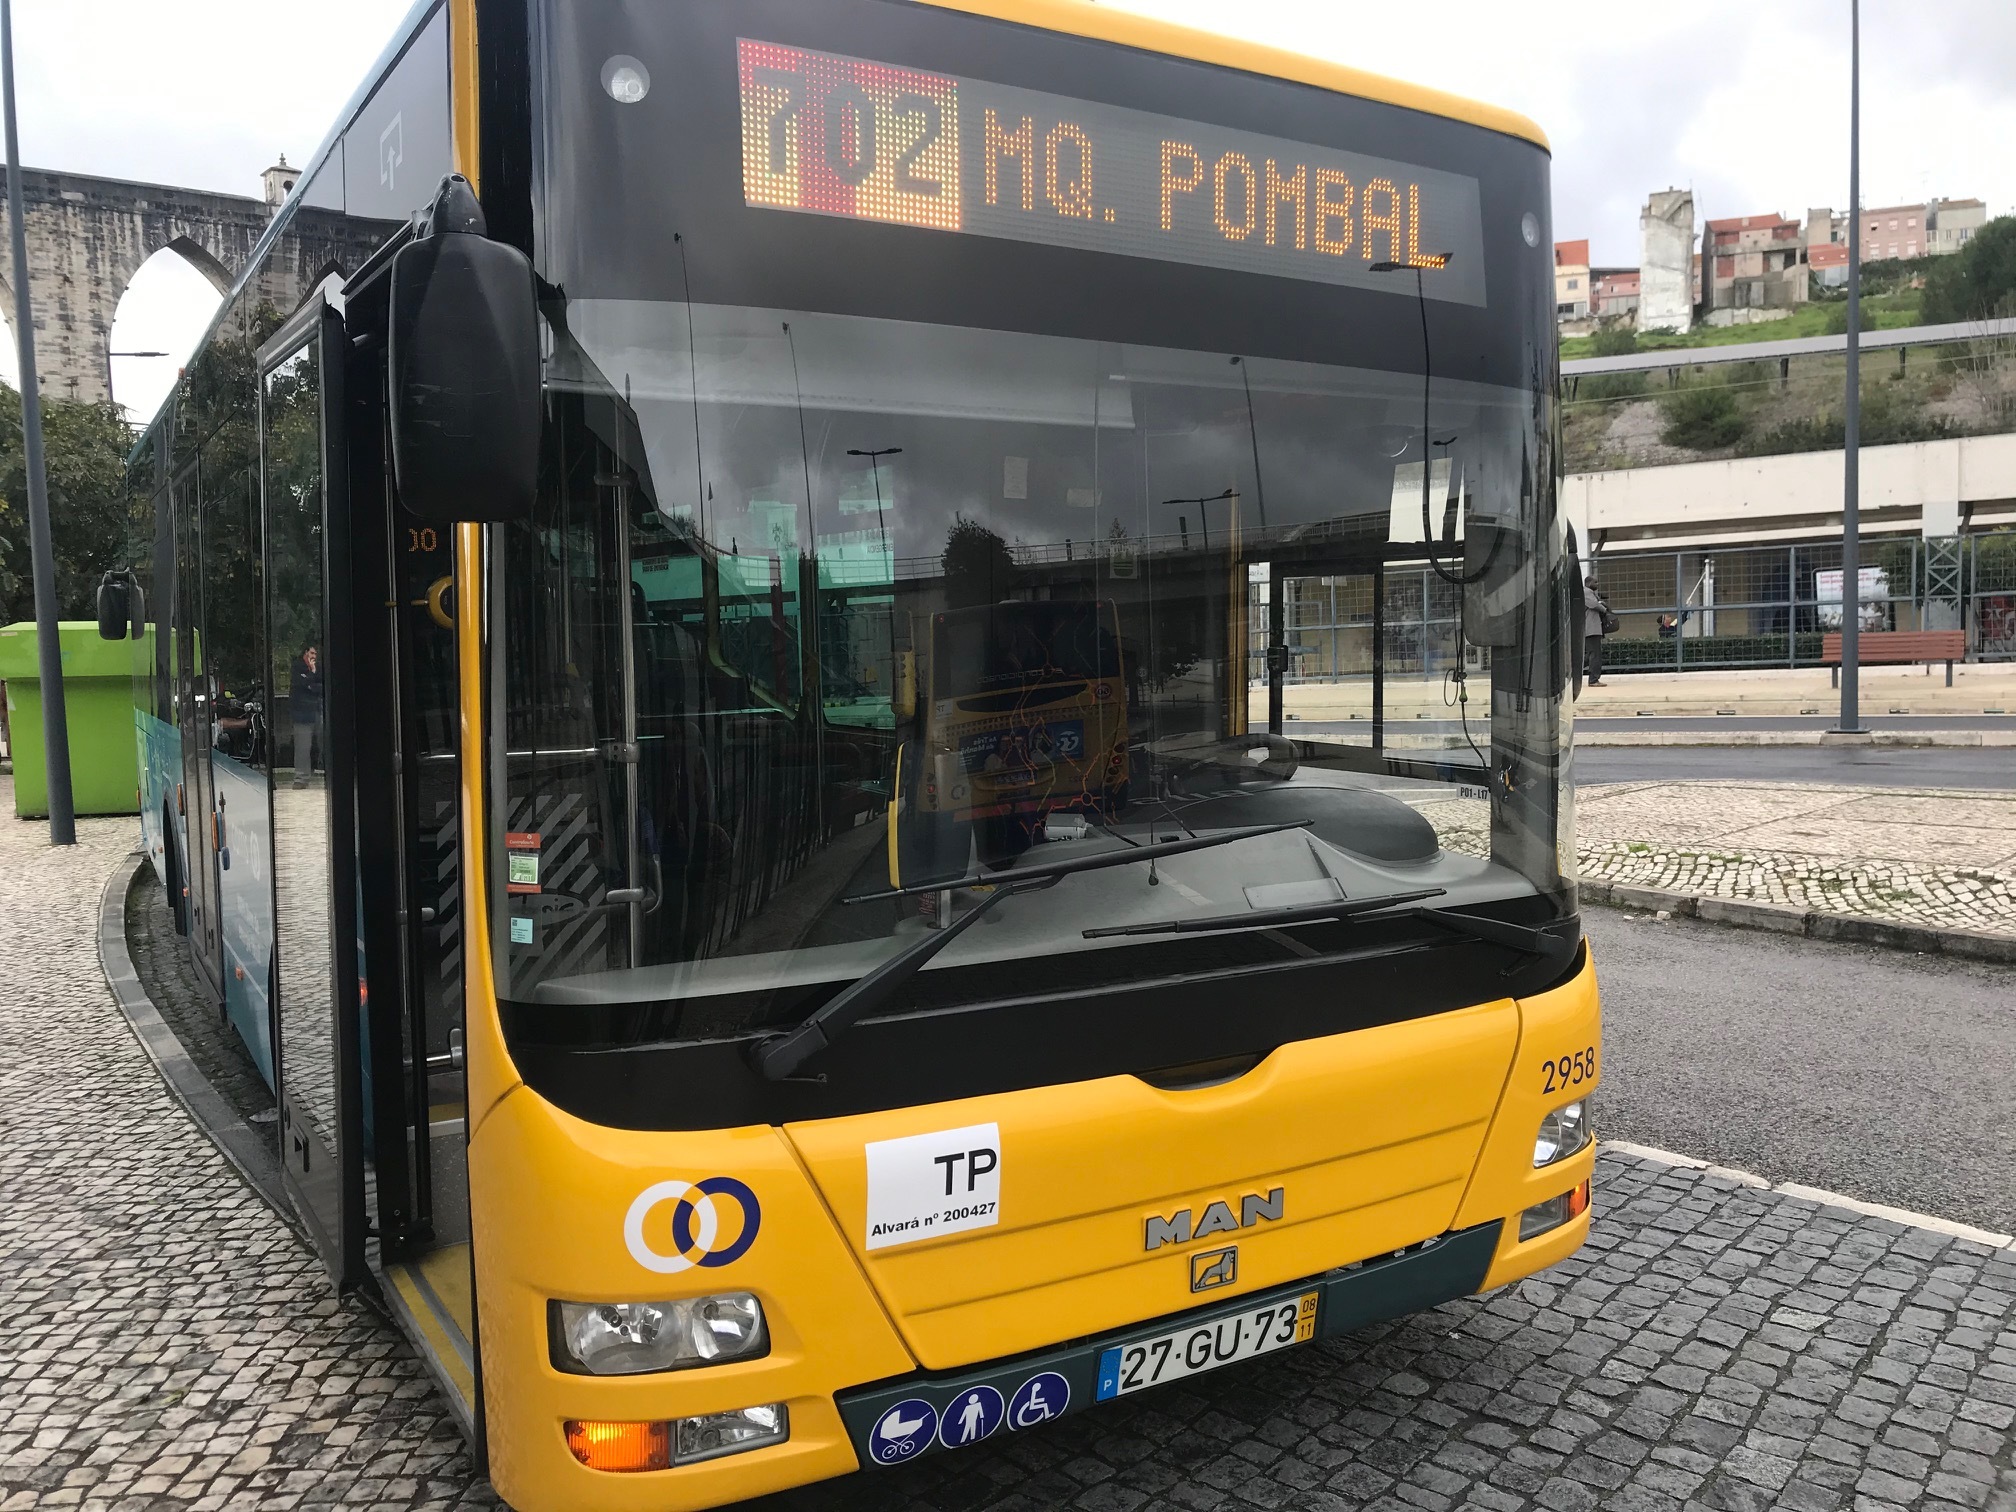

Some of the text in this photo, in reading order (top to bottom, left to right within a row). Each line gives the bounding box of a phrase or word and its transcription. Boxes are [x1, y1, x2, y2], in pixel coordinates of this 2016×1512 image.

[755, 66, 1447, 270] 702 MQ. POMBAL
[1541, 1046, 1594, 1095] 2958
[934, 1148, 997, 1195] TP
[871, 1217, 919, 1236] Alvará
[943, 1202, 996, 1223] 200427
[1145, 1187, 1284, 1250] MAN
[1302, 1298, 1316, 1313] 08
[1301, 1324, 1311, 1337] 11
[1103, 1380, 1112, 1391] P
